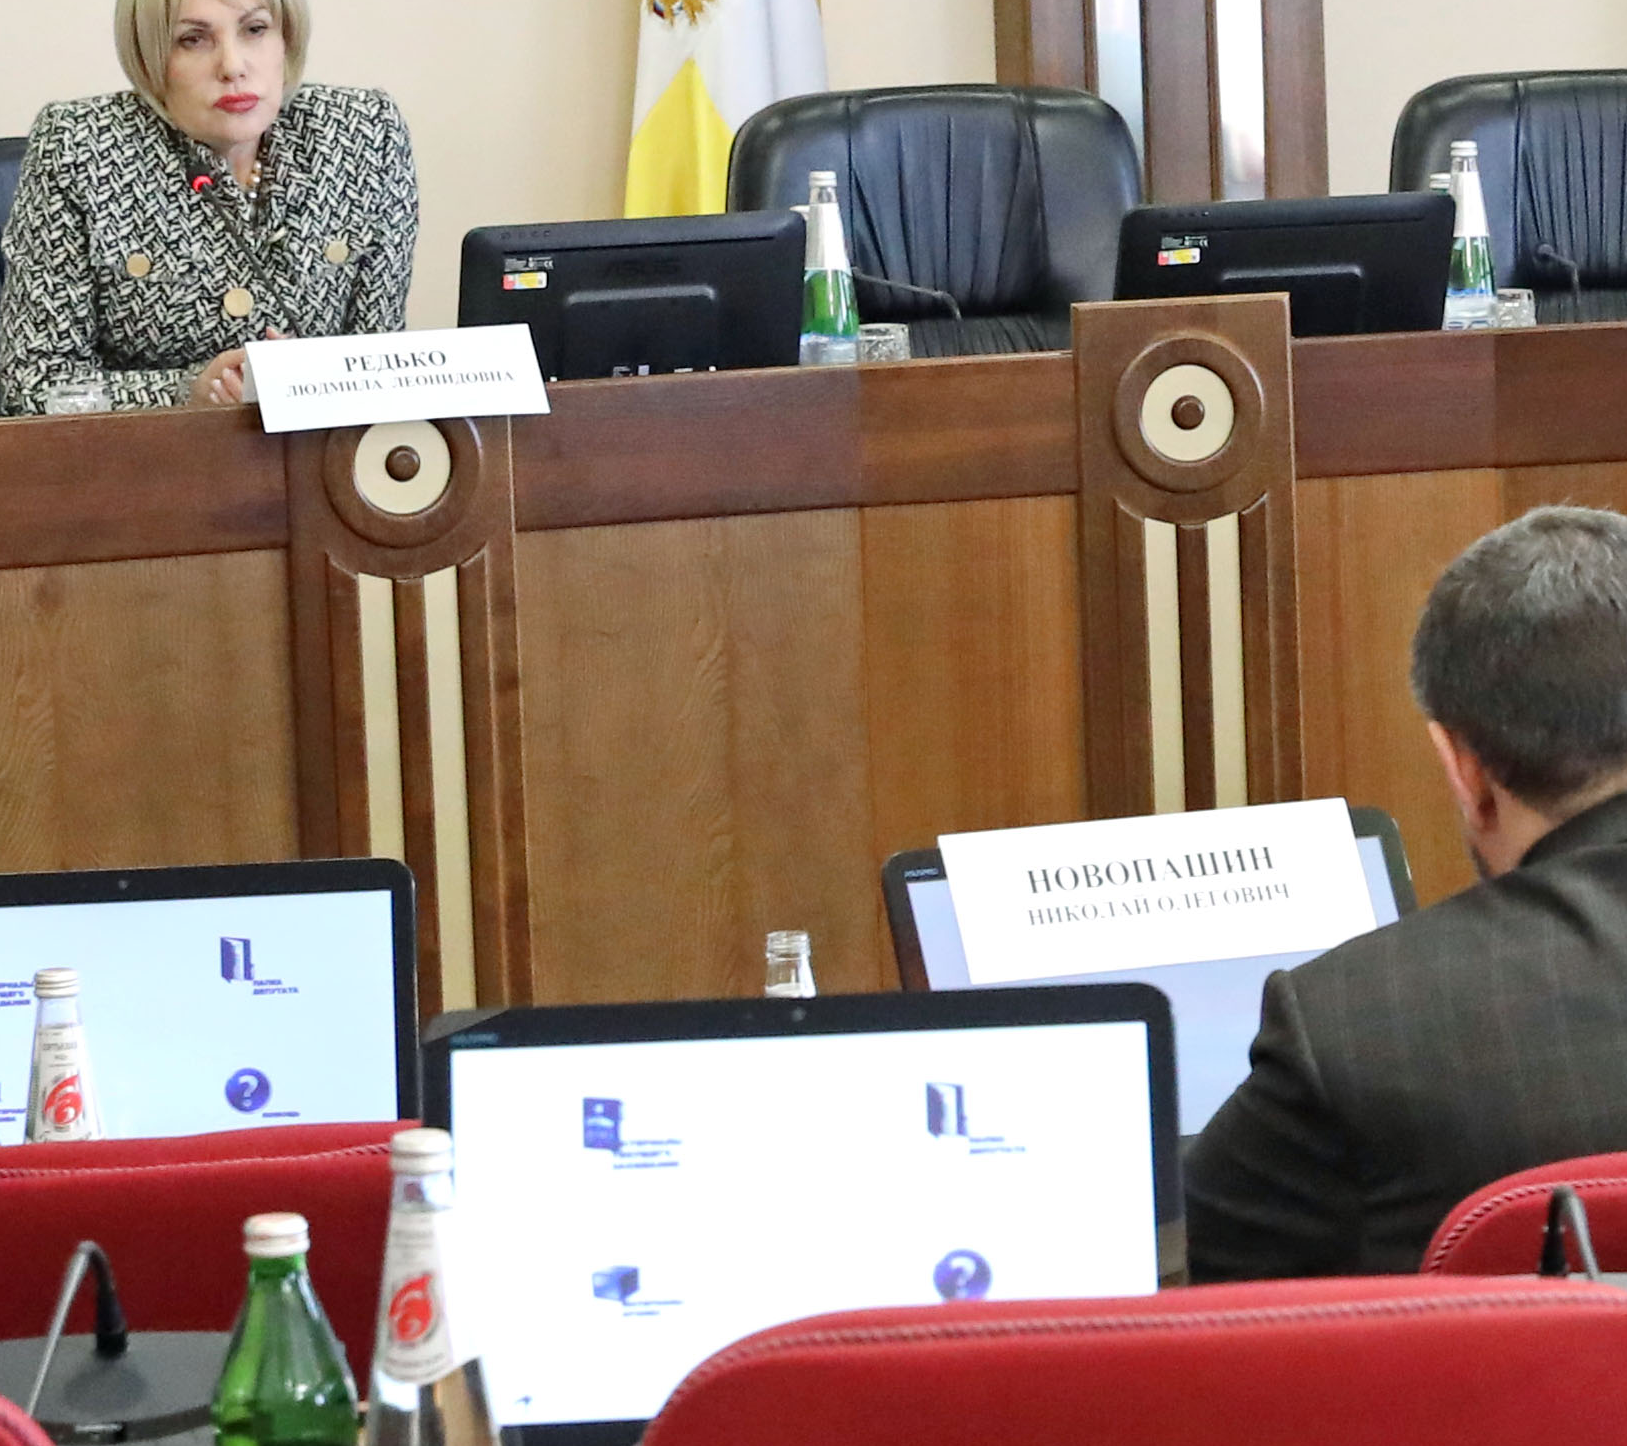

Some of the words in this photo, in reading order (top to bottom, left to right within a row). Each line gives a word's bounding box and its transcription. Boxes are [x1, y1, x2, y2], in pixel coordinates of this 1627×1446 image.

[344, 350, 447, 373] РЕДЬКО
[285, 378, 383, 398] ЛЮДМИЛА
[391, 370, 515, 391] ЛЕОНИДОВНА
[1027, 846, 1275, 894] НОВОПАШИН
[1028, 900, 1152, 926] НИКОЛАЙ
[1158, 882, 1291, 911] ОЛЕГОВИЧ
